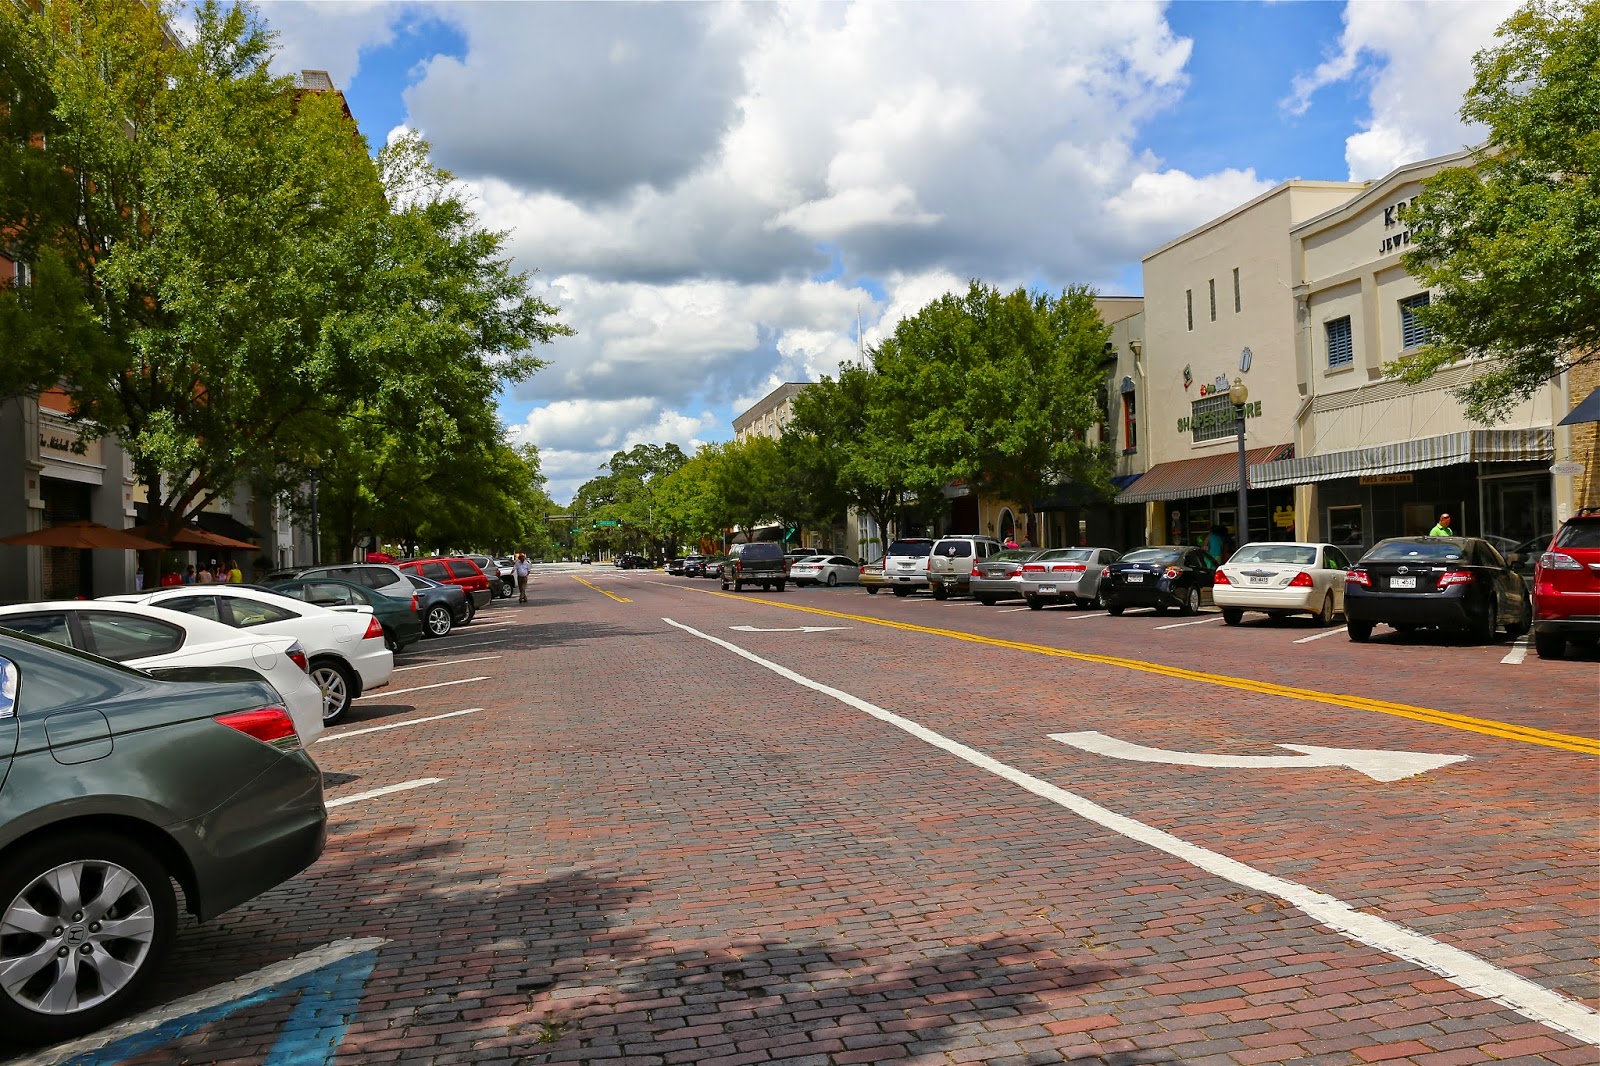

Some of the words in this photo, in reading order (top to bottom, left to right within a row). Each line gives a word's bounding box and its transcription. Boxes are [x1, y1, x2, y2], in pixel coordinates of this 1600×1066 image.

[1177, 411, 1216, 433] SHAPES
[1219, 408, 1228, 424] &
[1231, 400, 1262, 420] MRE
